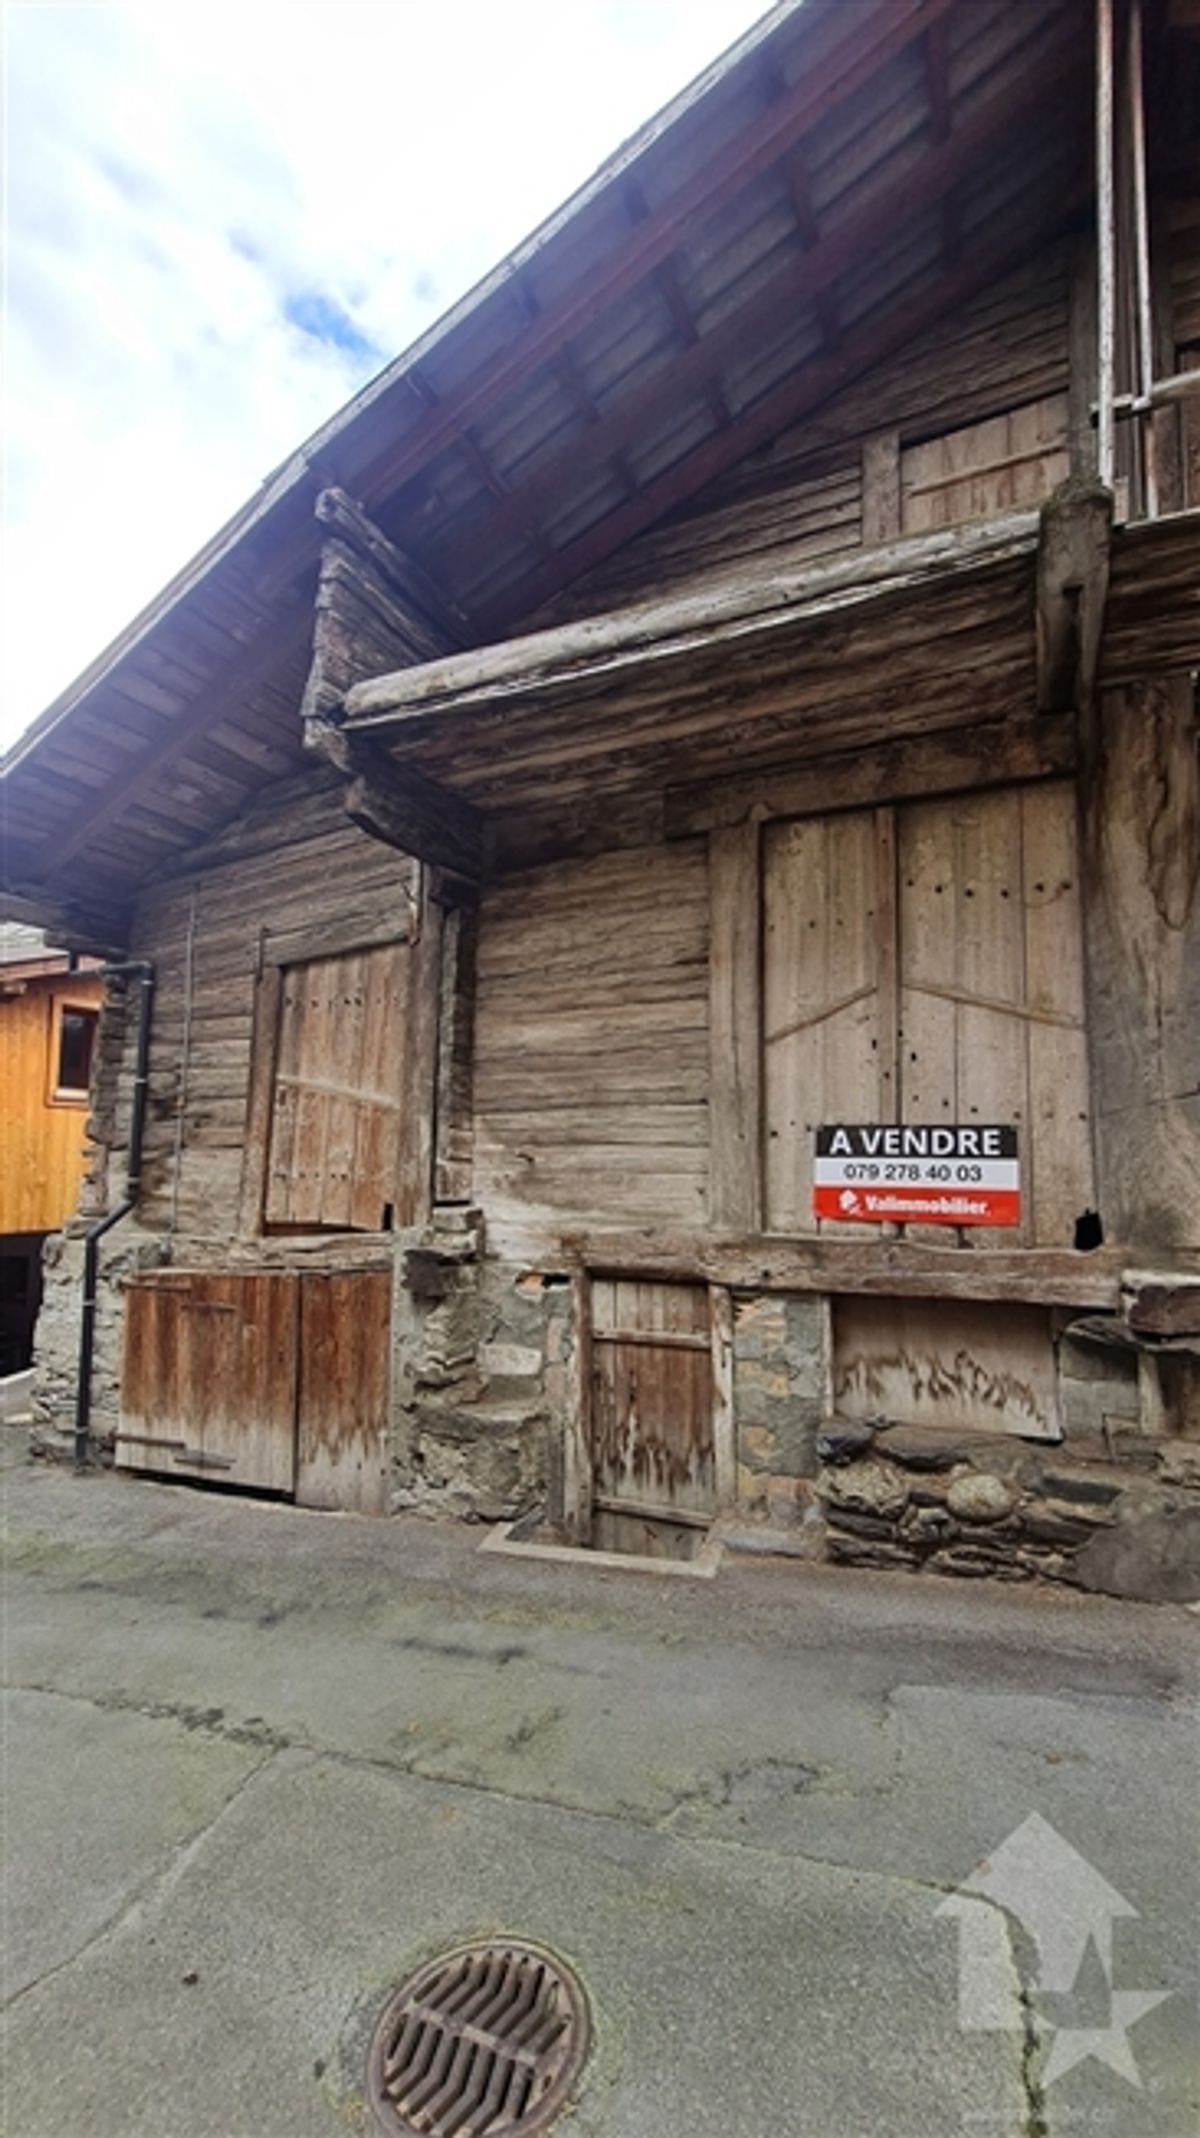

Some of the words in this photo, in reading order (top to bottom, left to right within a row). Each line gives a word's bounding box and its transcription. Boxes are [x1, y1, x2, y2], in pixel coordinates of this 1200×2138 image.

[829, 1128, 853, 1155] A
[860, 1128, 1001, 1156] VENDRE
[843, 1163, 880, 1180] 079
[884, 1164, 920, 1181] 278
[925, 1164, 951, 1182] 40
[956, 1165, 982, 1182] 03
